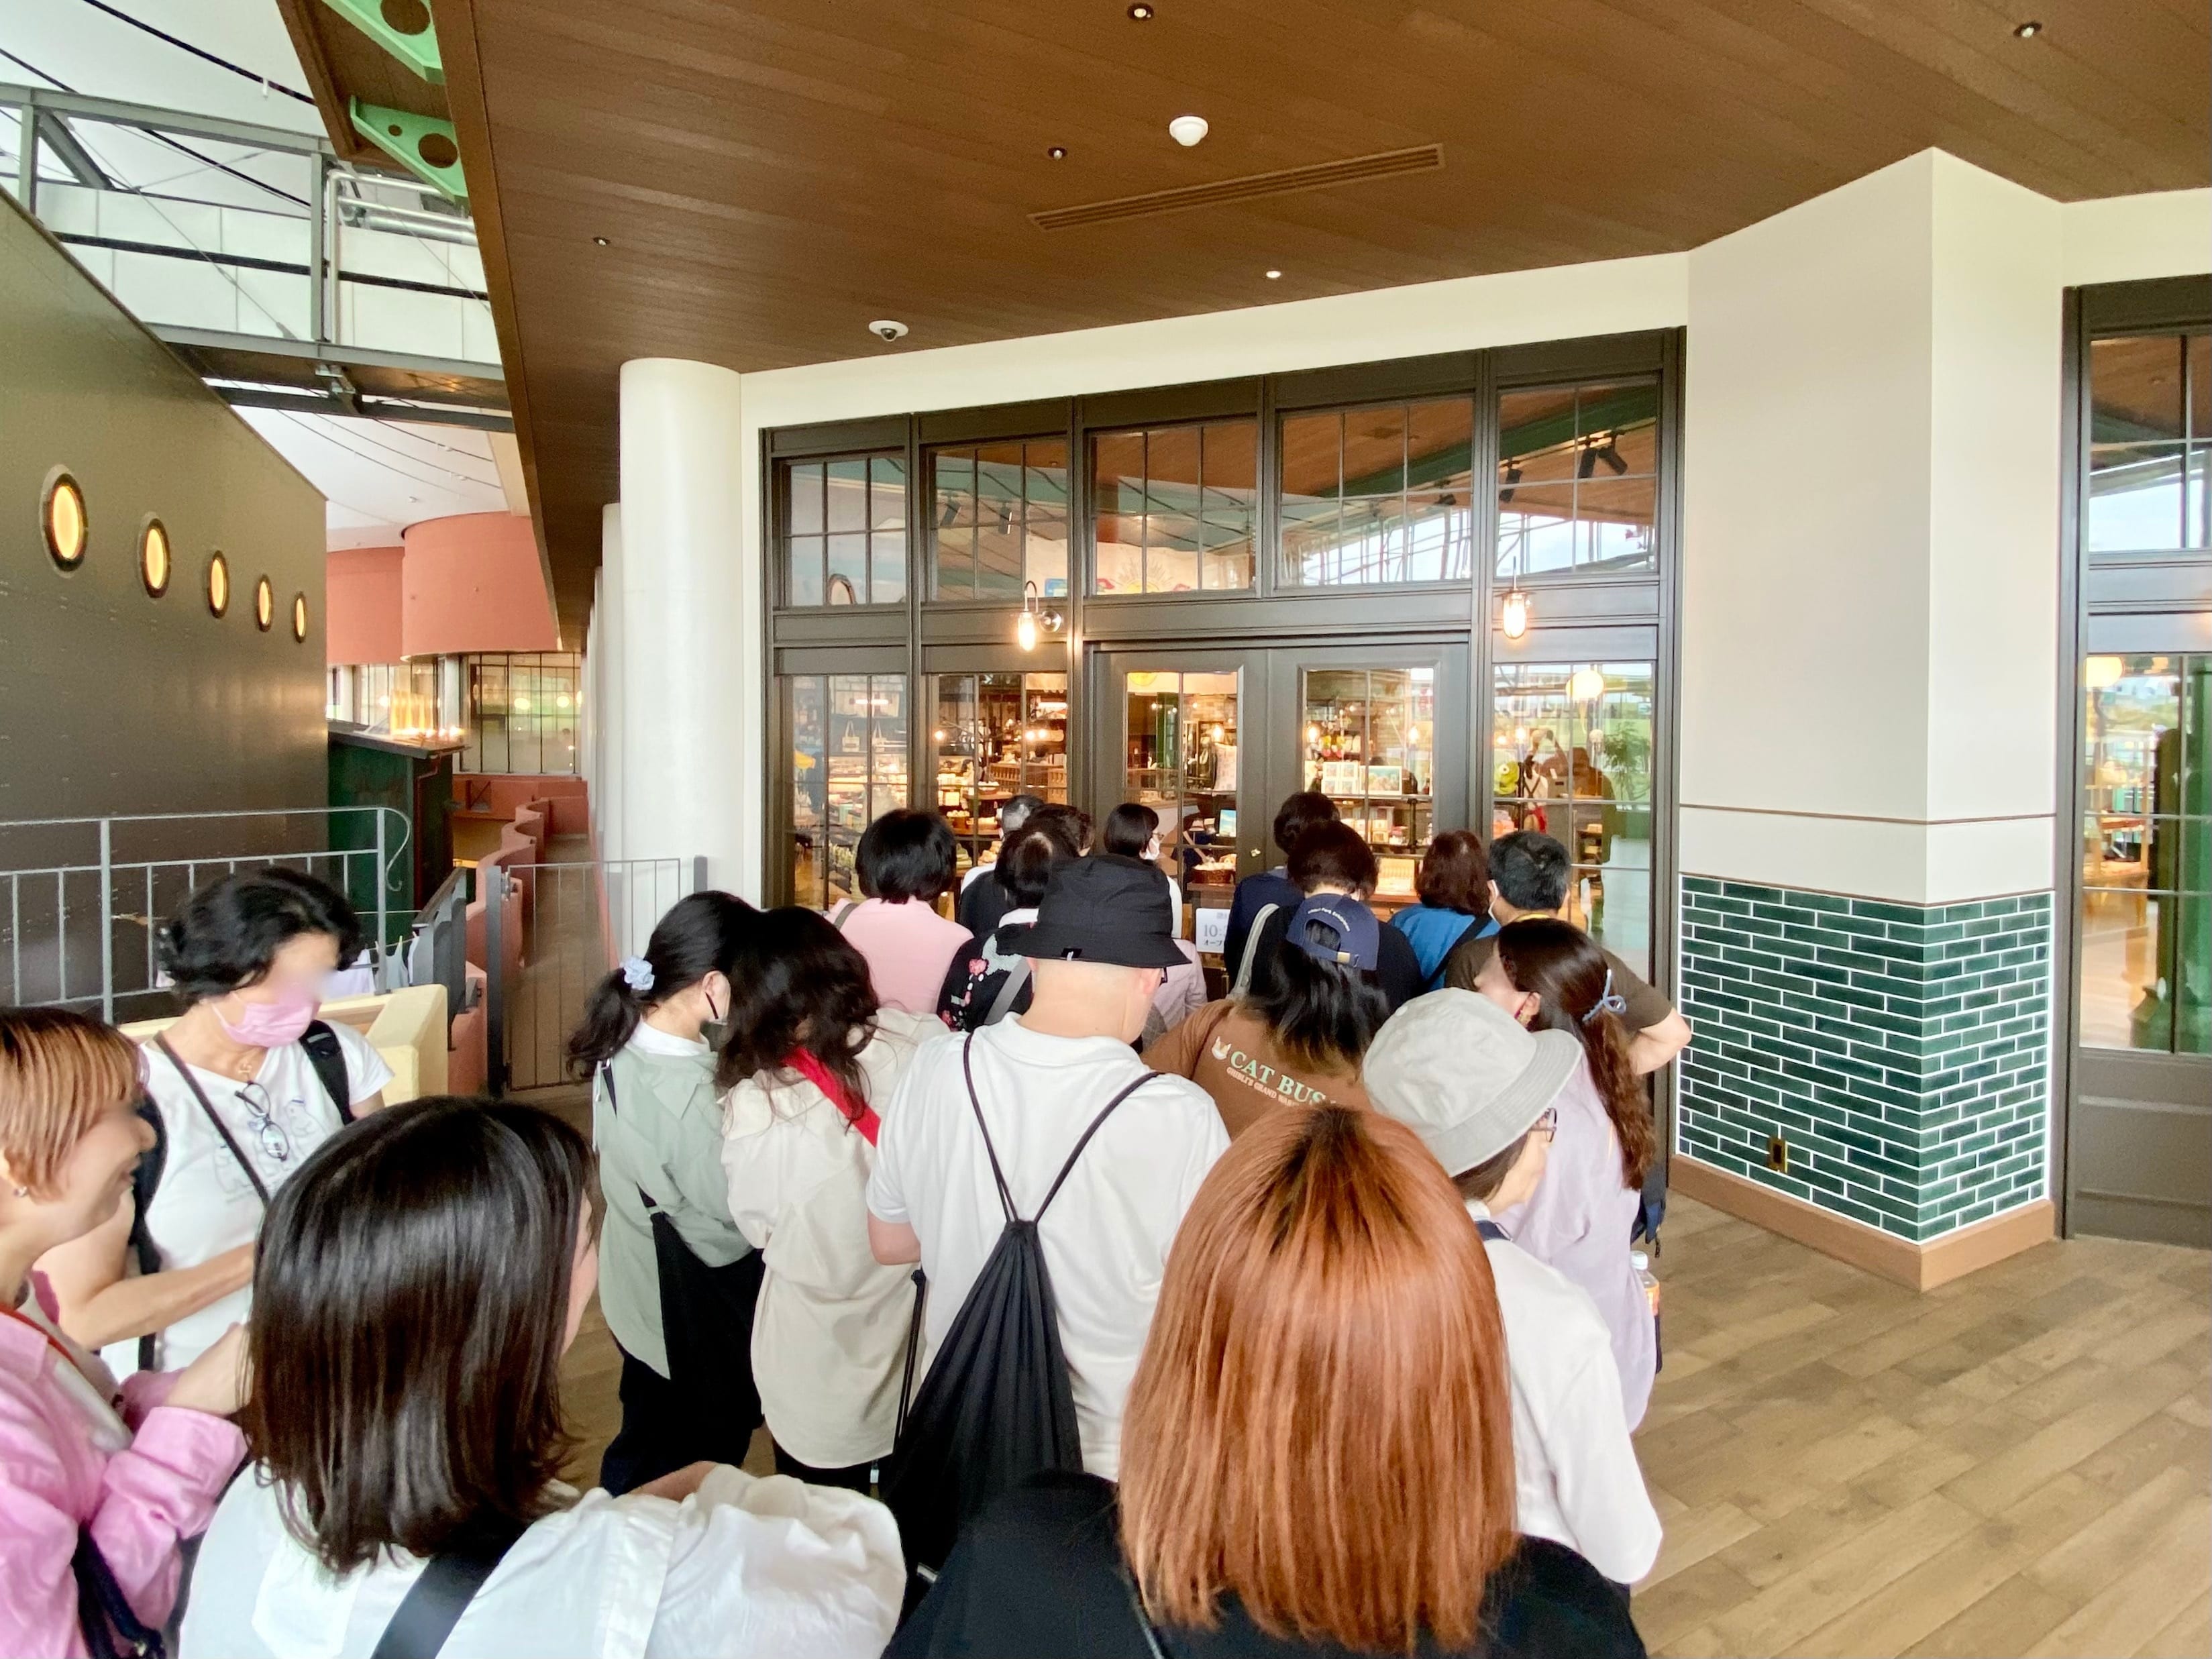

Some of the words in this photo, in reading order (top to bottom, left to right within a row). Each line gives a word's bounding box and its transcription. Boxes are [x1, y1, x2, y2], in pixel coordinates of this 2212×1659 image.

[1204, 924, 1226, 938] 10:
[1230, 1051, 1275, 1084] CAT
[1277, 1074, 1326, 1104] BUS
[1253, 1081, 1277, 1099] GRAND
